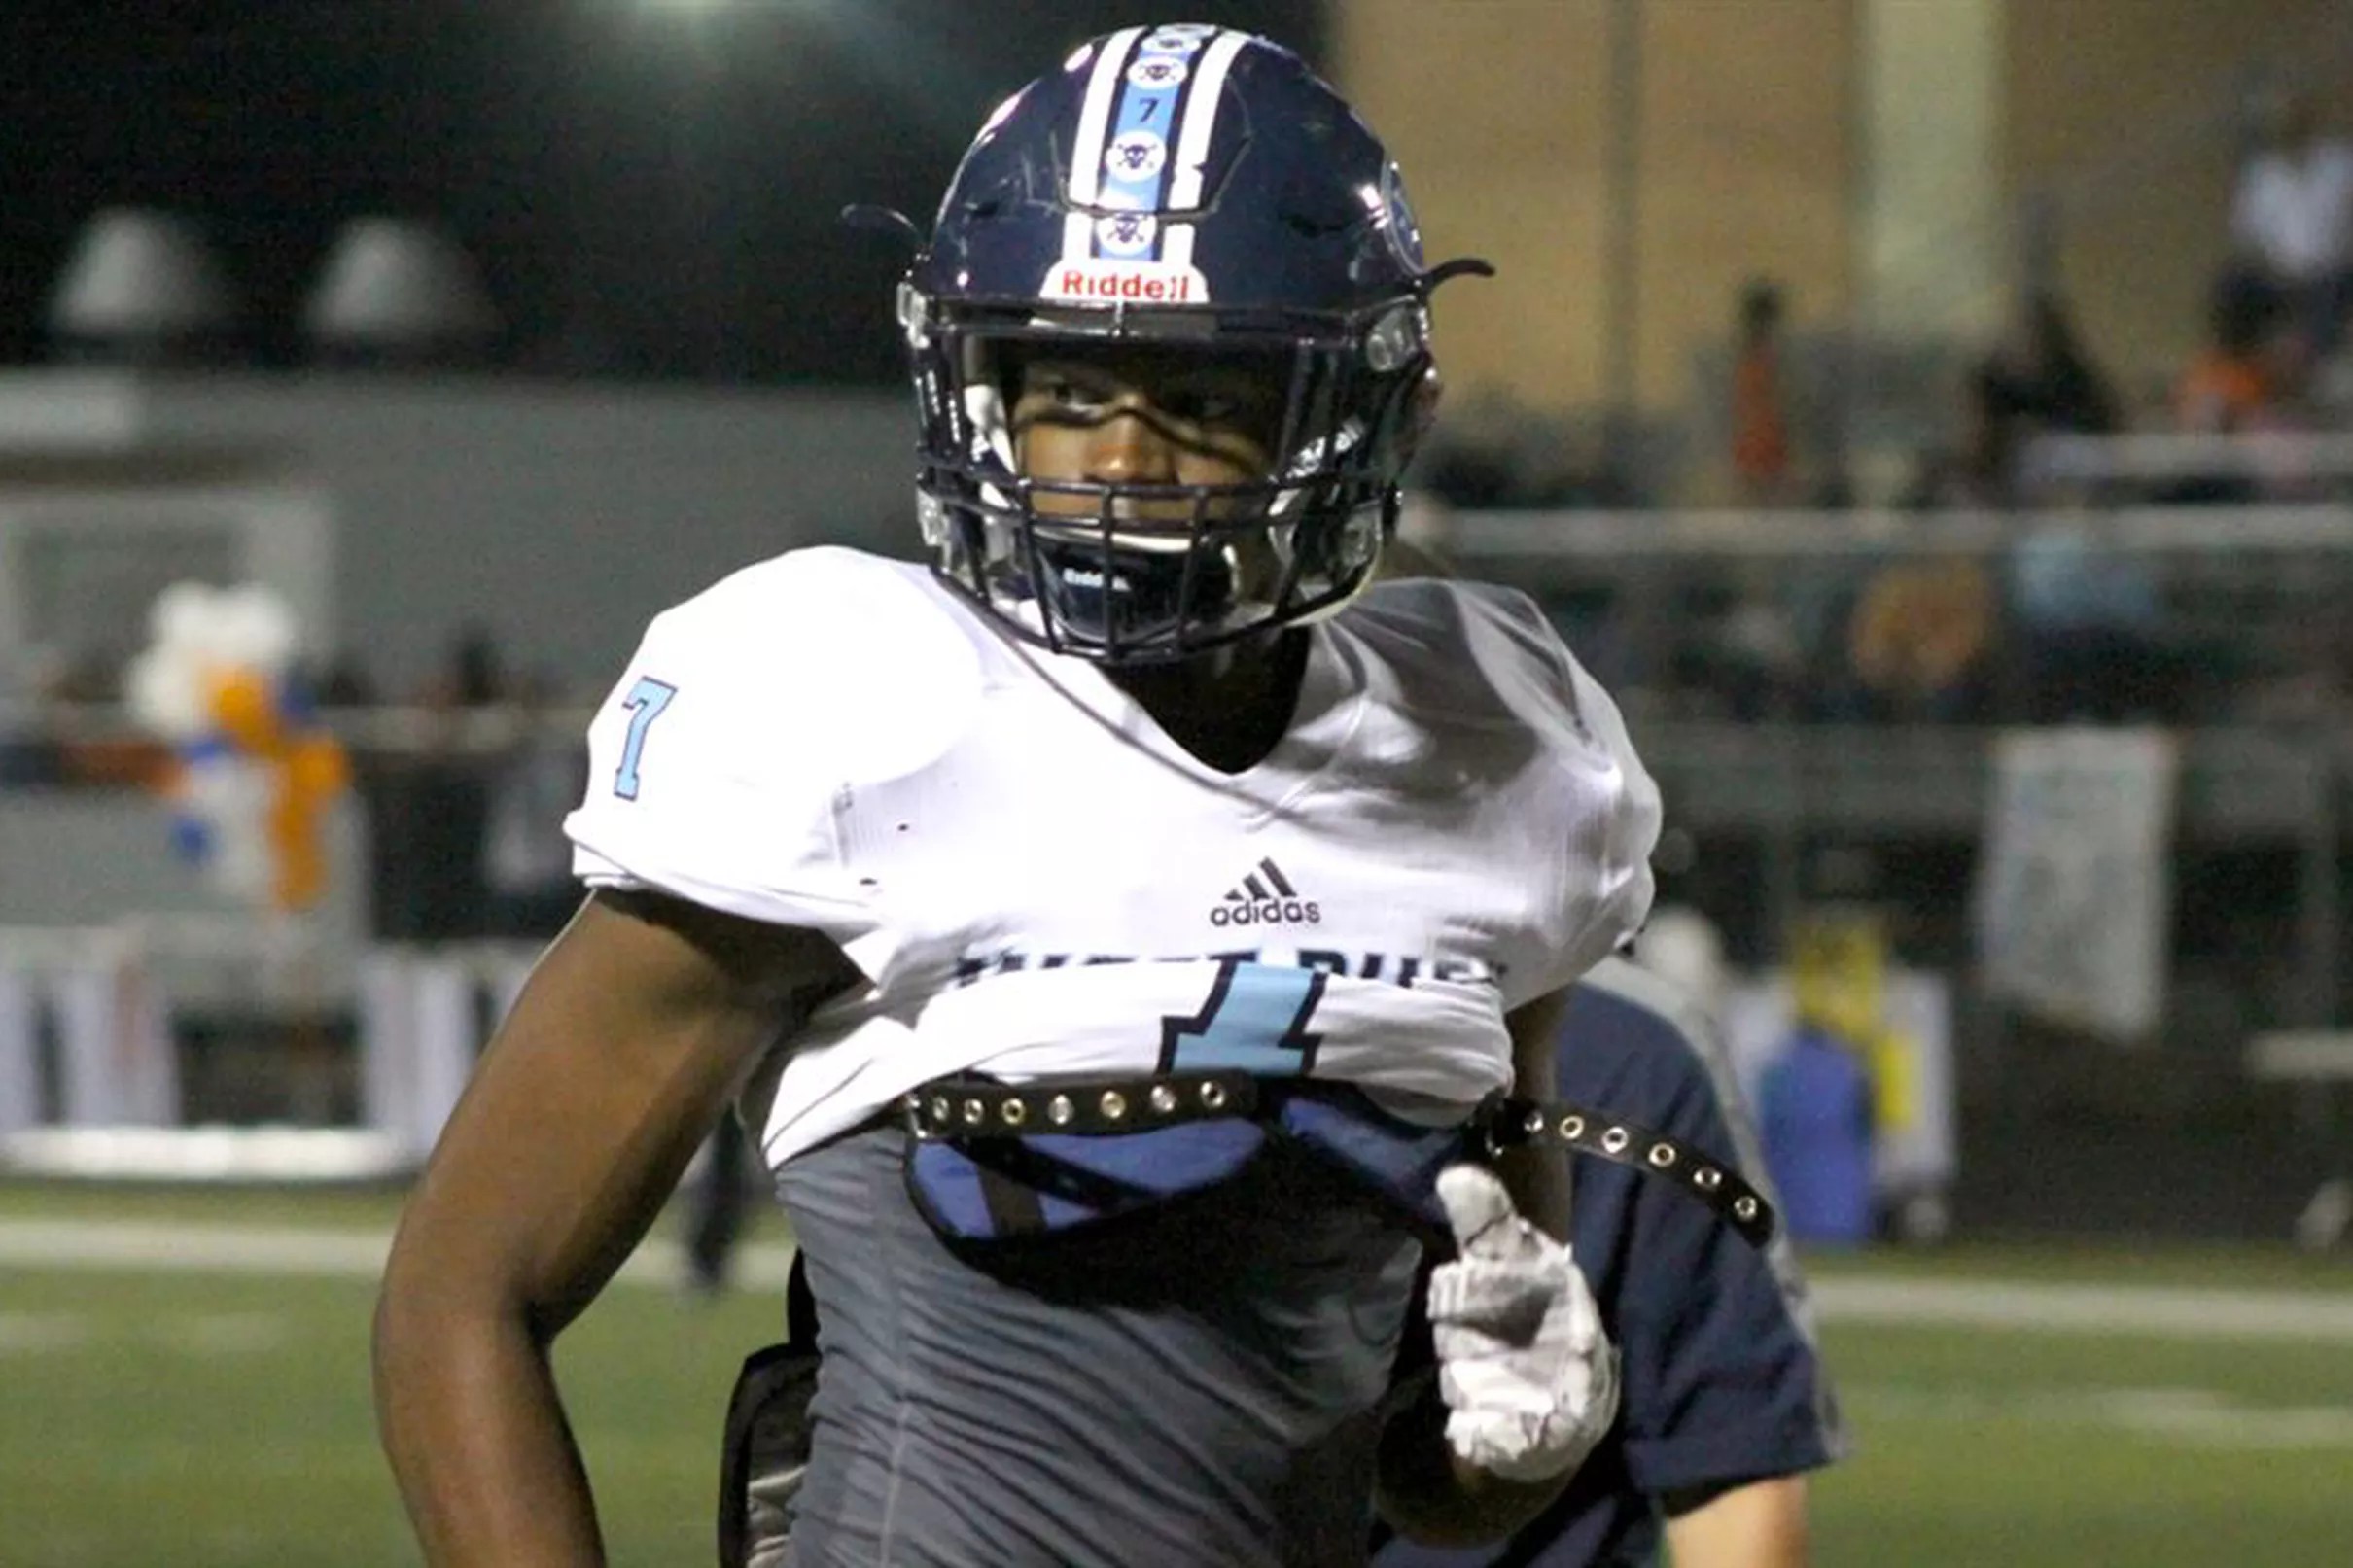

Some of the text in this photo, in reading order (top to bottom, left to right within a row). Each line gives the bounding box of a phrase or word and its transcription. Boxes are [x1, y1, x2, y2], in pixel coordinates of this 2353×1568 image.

[1138, 98, 1160, 122] 7
[1063, 270, 1189, 300] Riddell
[613, 675, 679, 802] 7
[1210, 897, 1321, 926] adidas
